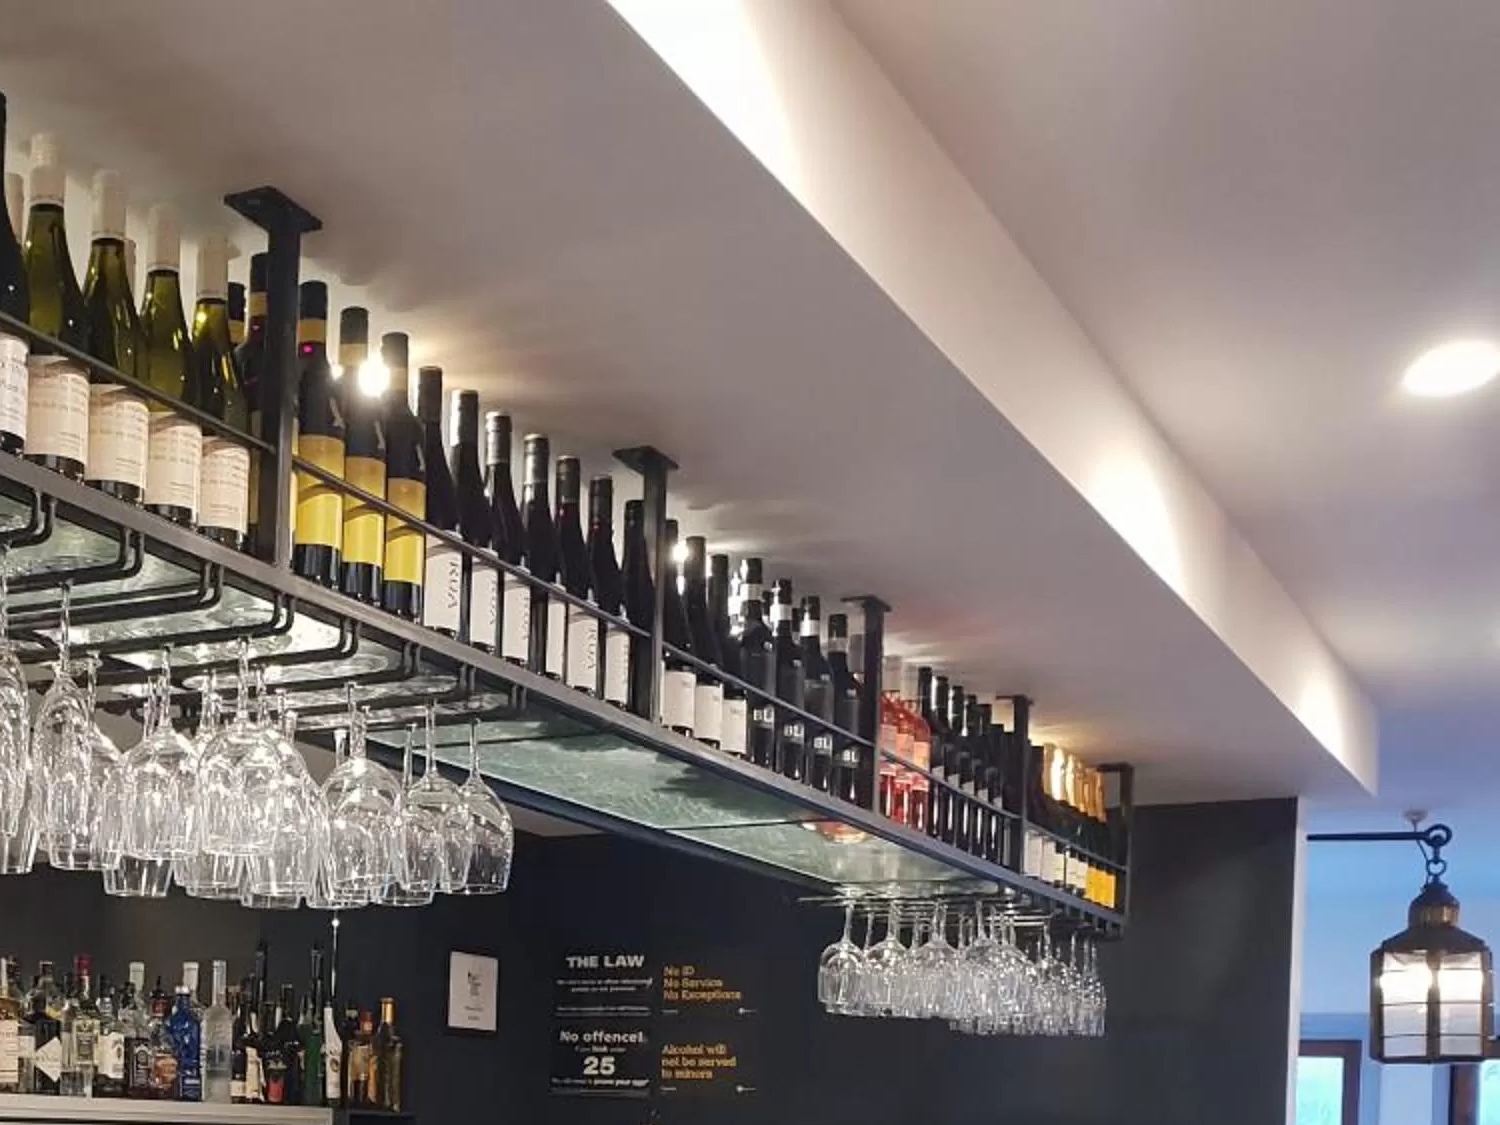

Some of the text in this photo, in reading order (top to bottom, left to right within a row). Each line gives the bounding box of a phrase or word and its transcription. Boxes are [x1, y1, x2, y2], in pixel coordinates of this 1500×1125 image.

[565, 955, 645, 969] THE LAW
[559, 1031, 579, 1042] No
[583, 1056, 616, 1076] 25
